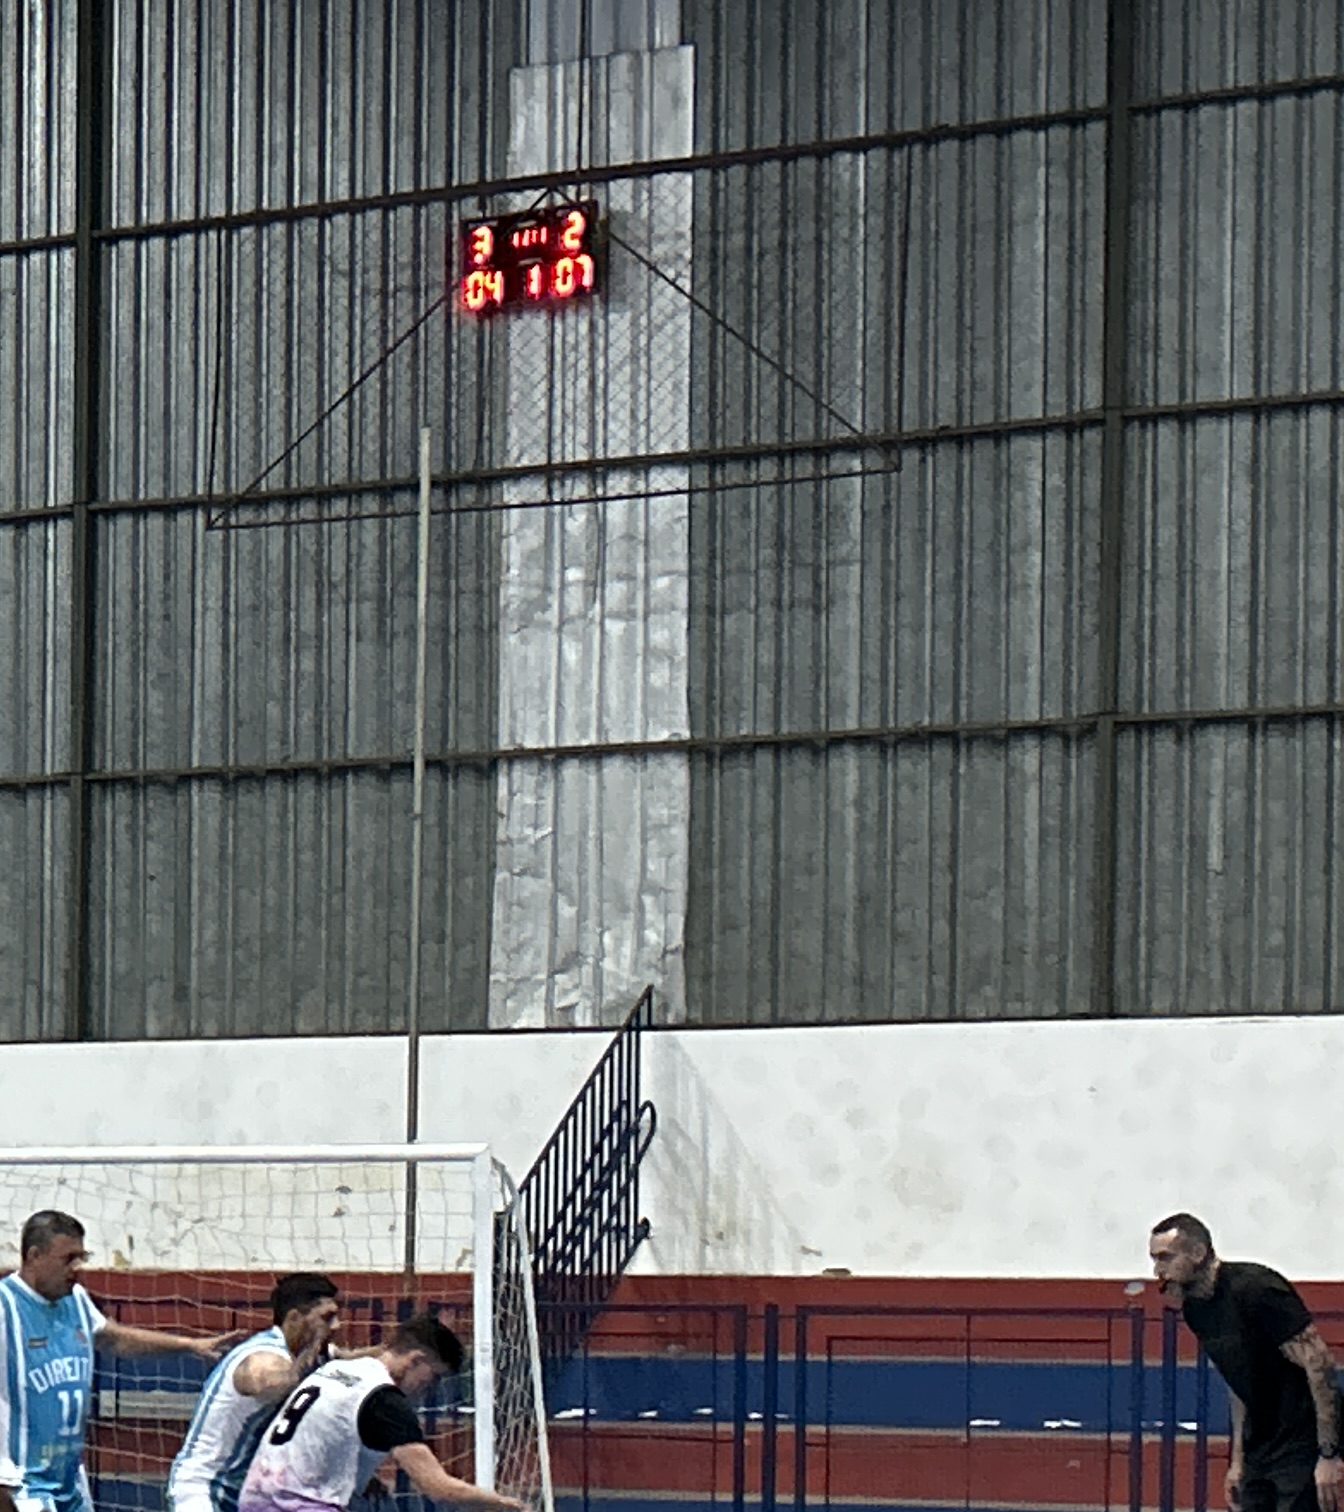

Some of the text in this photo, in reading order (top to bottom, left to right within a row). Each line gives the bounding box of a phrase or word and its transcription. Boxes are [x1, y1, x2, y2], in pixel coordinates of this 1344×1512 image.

[563, 211, 585, 250] 2
[465, 270, 504, 309] 04
[28, 1356, 89, 1394] DIREIT
[57, 1389, 84, 1436] 11
[269, 1385, 321, 1445] 9
